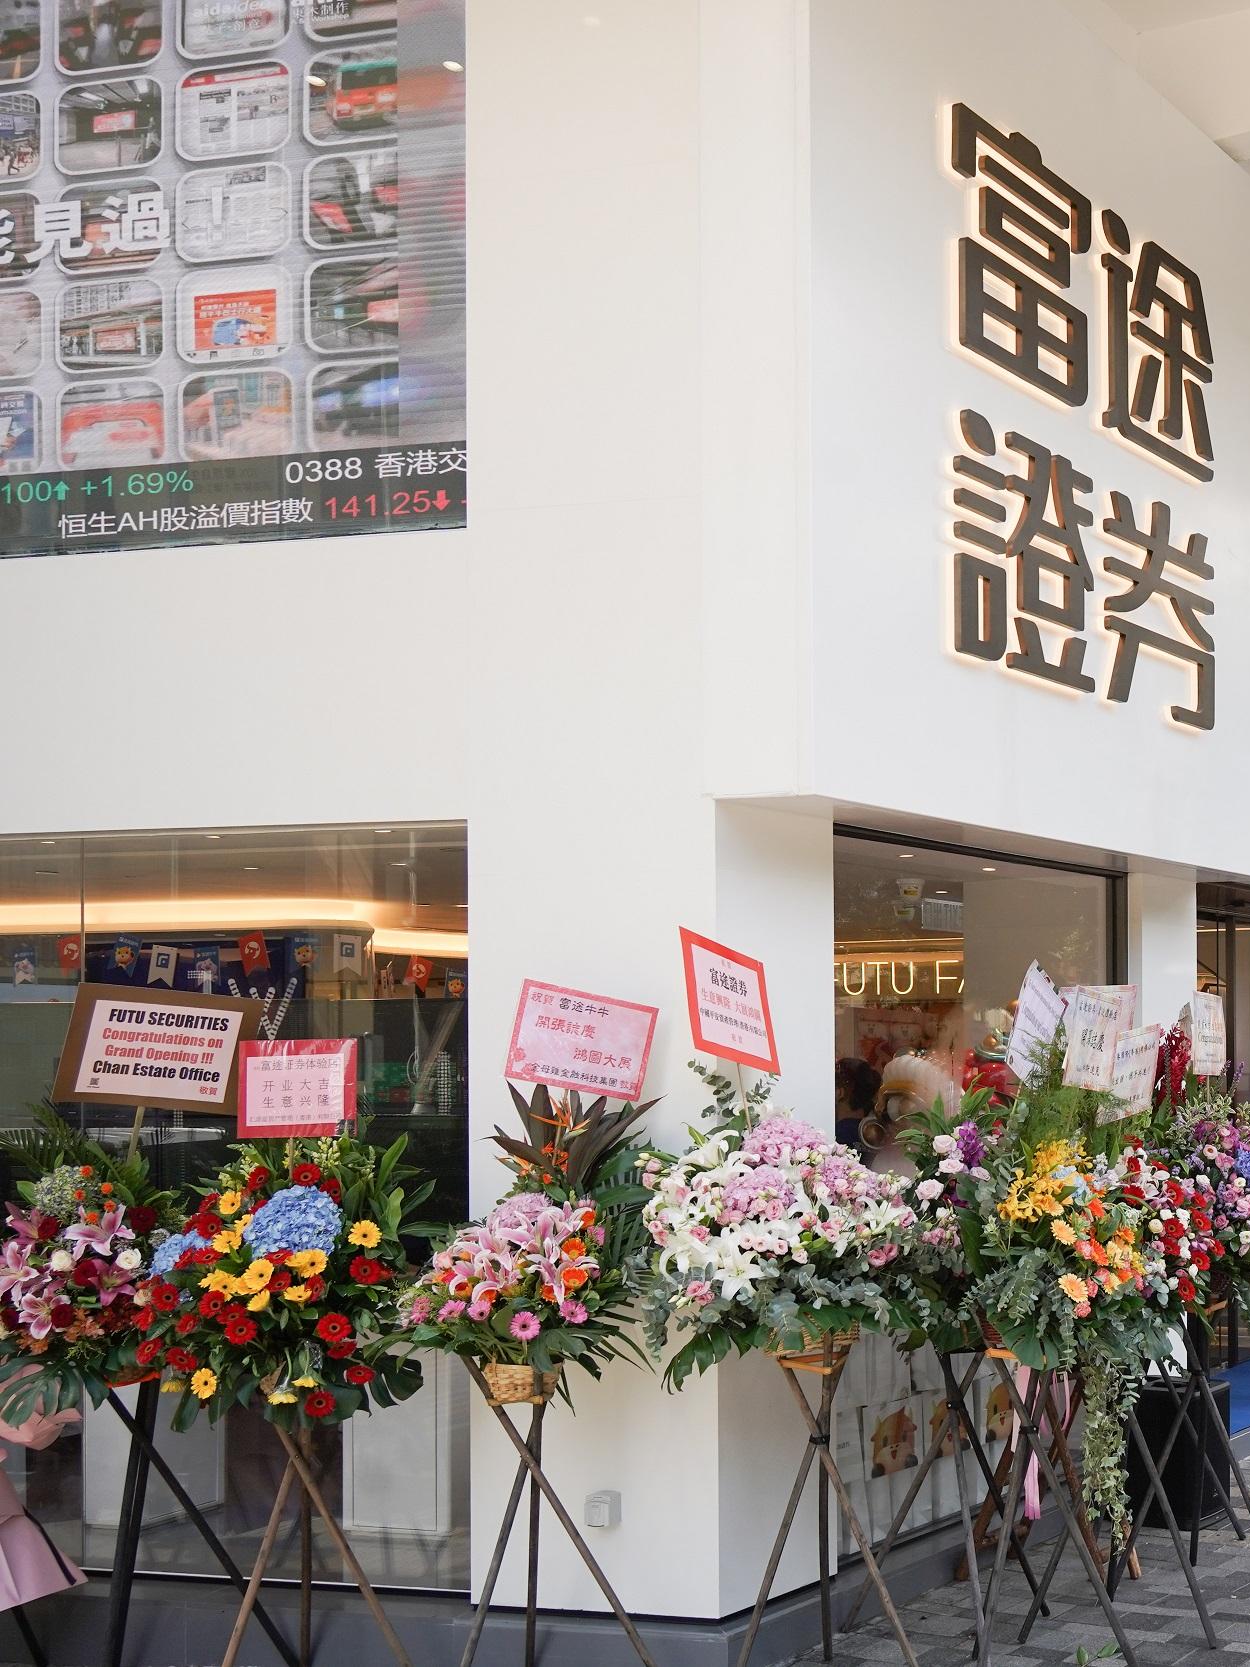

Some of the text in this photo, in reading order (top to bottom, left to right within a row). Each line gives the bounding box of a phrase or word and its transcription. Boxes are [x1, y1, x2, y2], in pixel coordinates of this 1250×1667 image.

[951, 102, 1215, 483] 富途
[285, 457, 363, 483] 0388
[374, 447, 466, 479] 香港交
[81, 470, 194, 496] +1.69%
[58, 489, 431, 539] 恒生AH股溢價指數 141.25
[952, 408, 1216, 731] 證券
[559, 996, 610, 1018] 富途牛牛
[108, 1008, 230, 1032] FUTU SECURITIES
[535, 1015, 597, 1040] 開張誌慶
[102, 1027, 224, 1049] Congratulations on
[104, 1044, 215, 1065] Grand Opening !!!
[573, 1047, 632, 1070] 鴻圖大展
[92, 1060, 221, 1083] Chan Estate Office
[262, 1078, 330, 1093] 开业大吉
[261, 1094, 330, 1109] 生意兴隆
